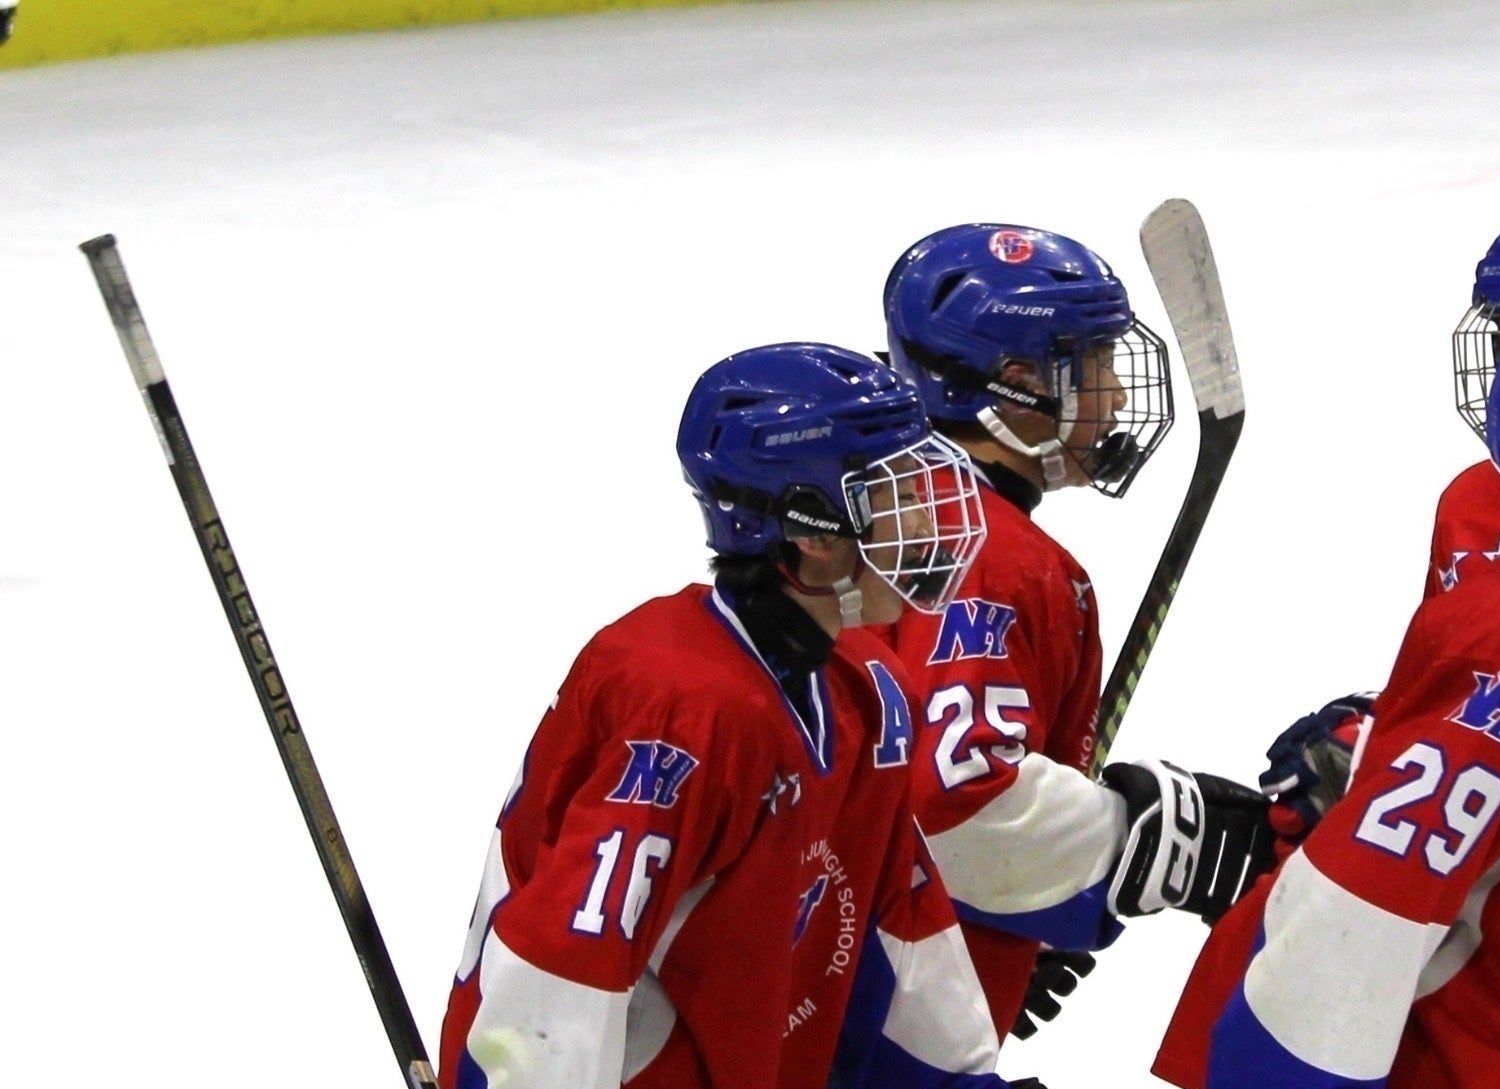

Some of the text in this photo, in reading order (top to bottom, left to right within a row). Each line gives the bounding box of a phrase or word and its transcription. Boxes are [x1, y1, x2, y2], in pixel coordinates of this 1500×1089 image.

[764, 425, 833, 447] BAUER
[986, 382, 1038, 406] BAUER
[786, 509, 841, 532] BAUER
[865, 660, 912, 769] A
[926, 684, 1031, 790] 25
[568, 827, 672, 942] 16
[825, 886, 856, 977] SCHOOL
